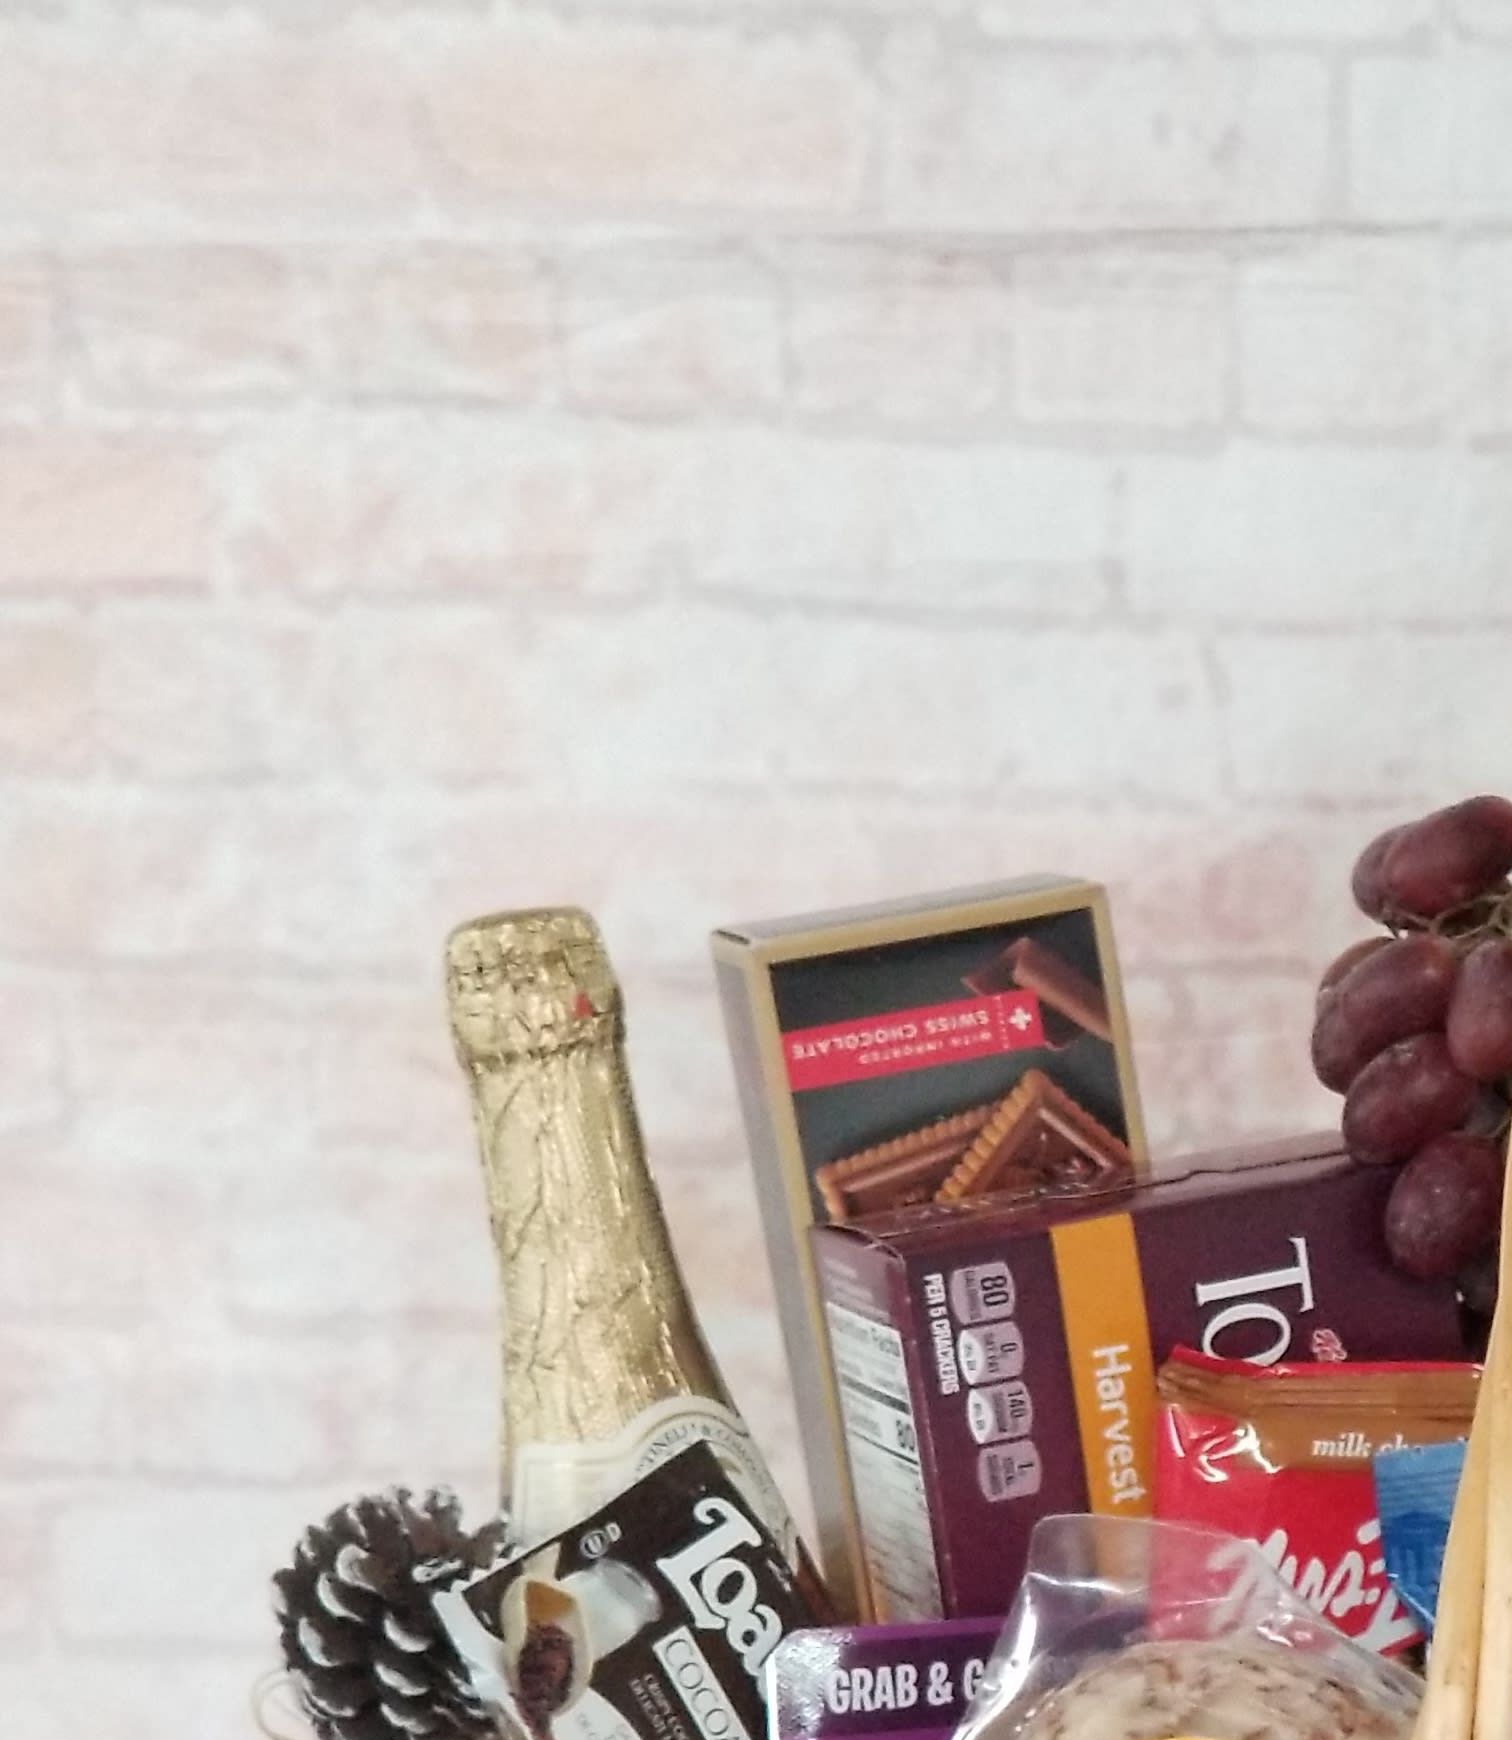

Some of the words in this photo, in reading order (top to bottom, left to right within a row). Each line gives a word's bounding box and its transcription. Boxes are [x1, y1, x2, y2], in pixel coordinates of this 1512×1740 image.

[791, 1023, 918, 1060] CHOCOLATE
[923, 1273, 946, 1305] PER
[980, 1275, 1010, 1307] 80
[931, 1319, 960, 1395] CRACKERS
[1093, 1344, 1148, 1504] Harvest
[1312, 1432, 1372, 1458] milk
[827, 1663, 918, 1714] GRAB
[928, 1661, 954, 1706] &
